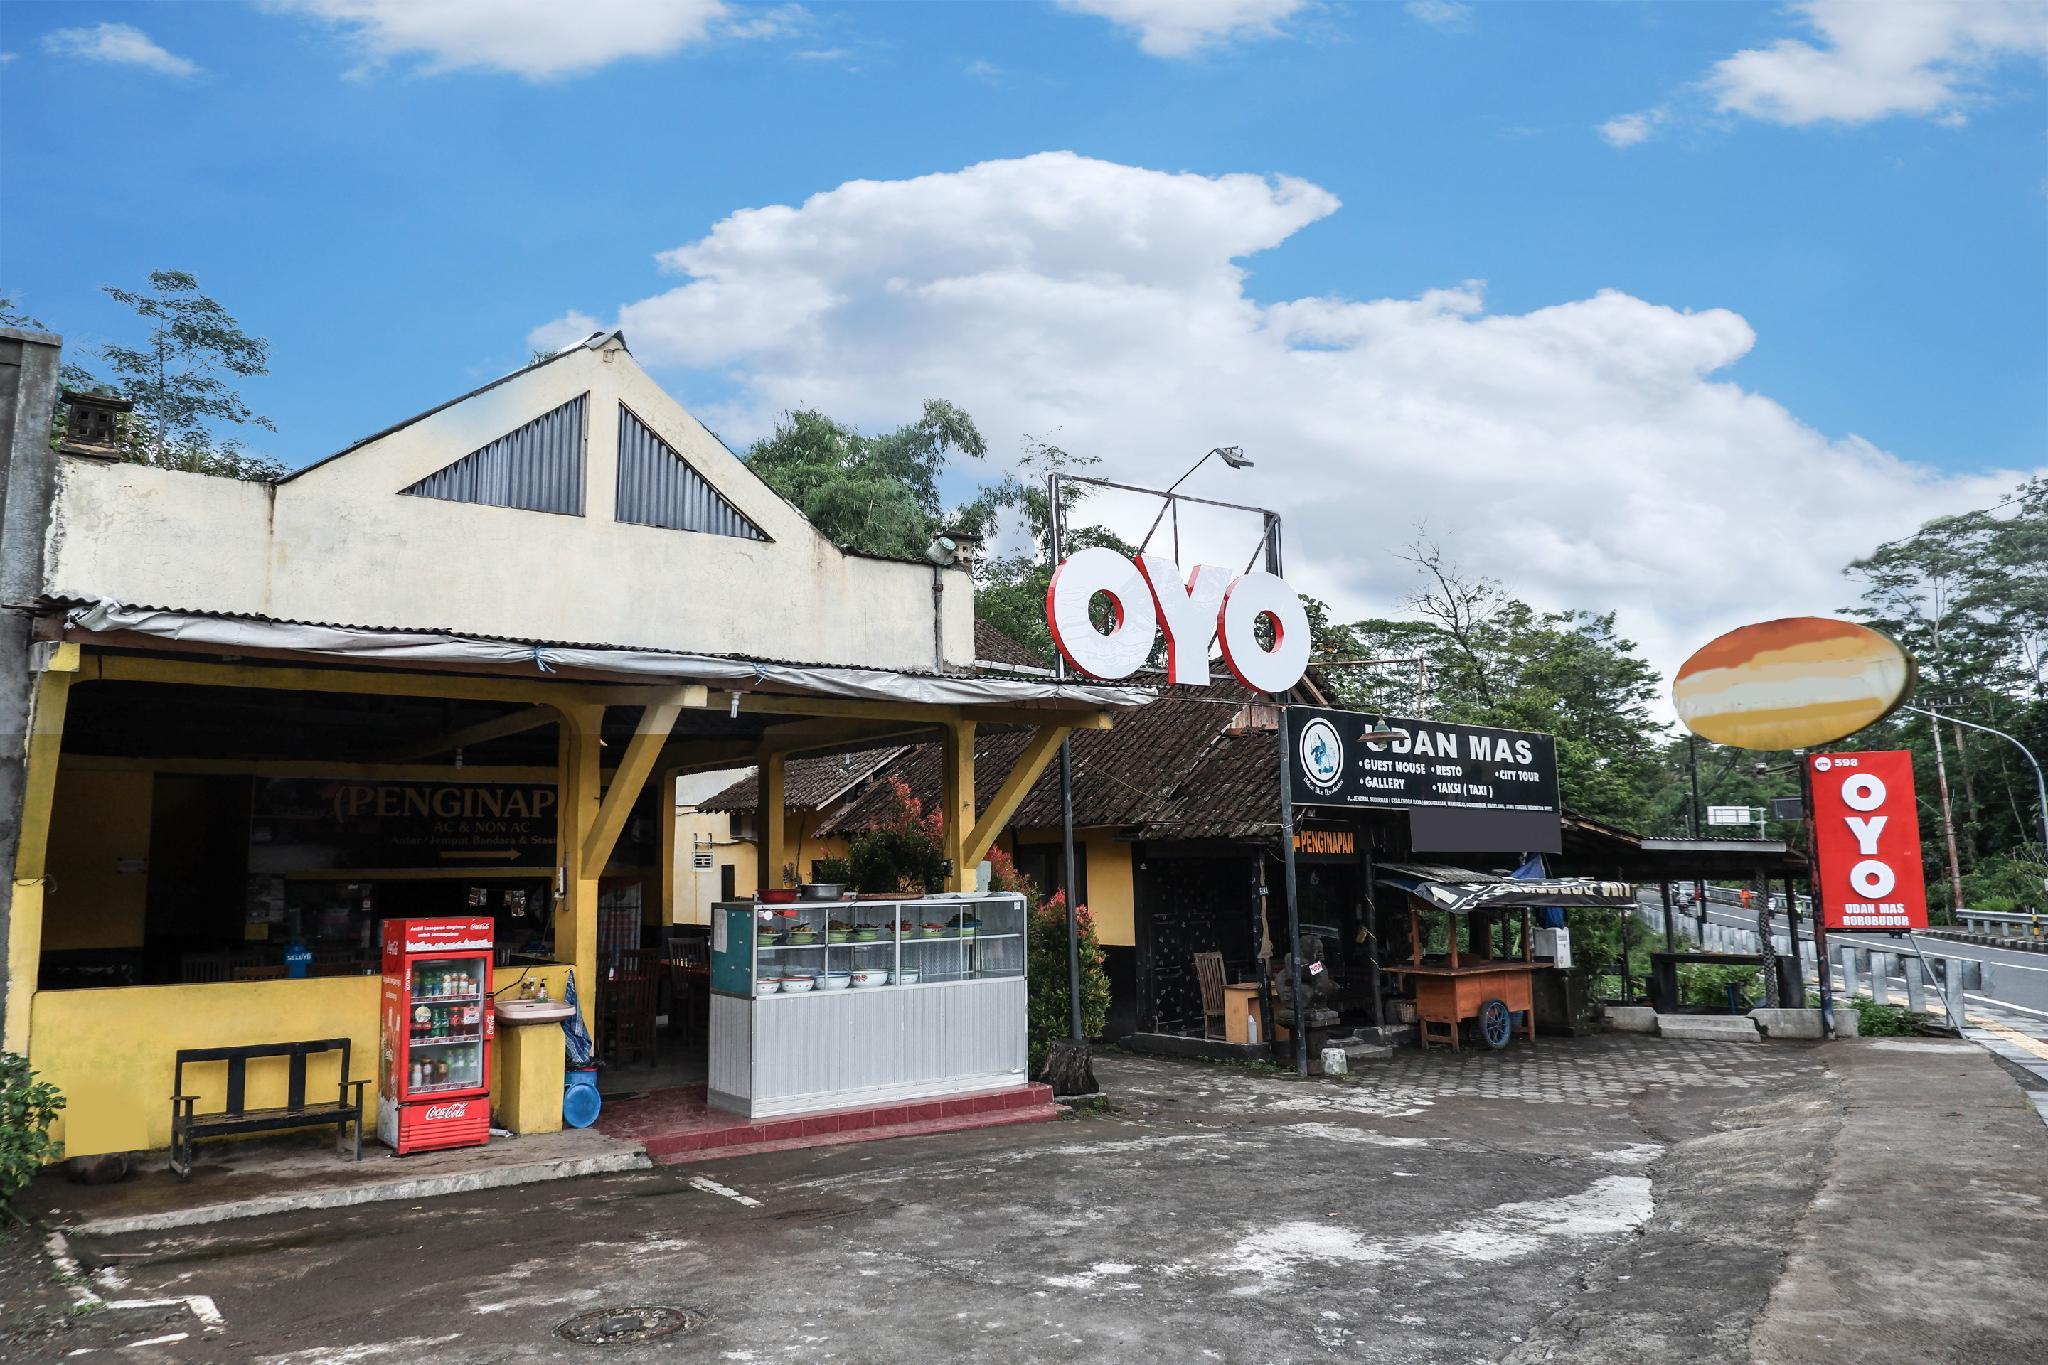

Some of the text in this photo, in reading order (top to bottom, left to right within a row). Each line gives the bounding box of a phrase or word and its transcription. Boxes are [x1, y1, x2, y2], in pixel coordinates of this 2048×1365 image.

[1046, 547, 1311, 692] OYO
[1469, 735, 1532, 764] MAS
[1364, 758, 1426, 774] GUEST HOUSE
[1436, 765, 1462, 777] RESTO
[1500, 769, 1540, 782] CITY TOUR
[1365, 776, 1405, 790] GALLERY
[1437, 782, 1462, 794] TAKSI
[434, 821, 530, 833] AC & NON AC
[1300, 830, 1354, 854] PENGINAPAN
[1841, 773, 1895, 899] OYO
[1845, 903, 1905, 914] UDAN MAS
[1842, 915, 1910, 926] BOROBUDUR
